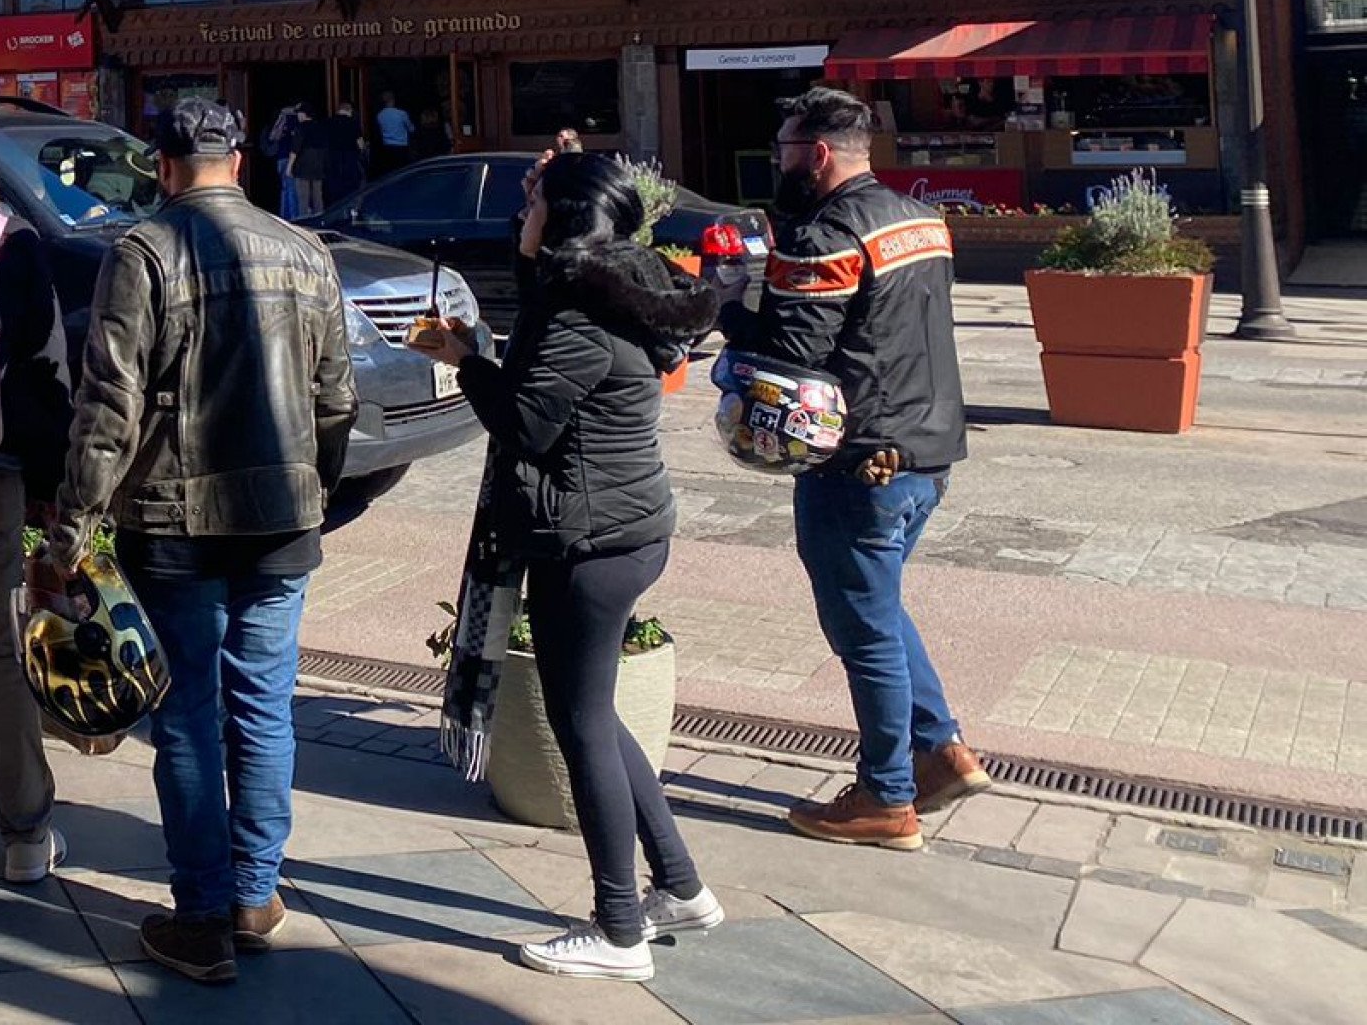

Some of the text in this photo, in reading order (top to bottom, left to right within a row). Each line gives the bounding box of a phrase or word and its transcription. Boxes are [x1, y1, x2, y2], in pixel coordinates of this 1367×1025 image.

[281, 22, 305, 39] de
[312, 21, 382, 38] cinema
[391, 16, 414, 34] de
[424, 11, 521, 39] gramado
